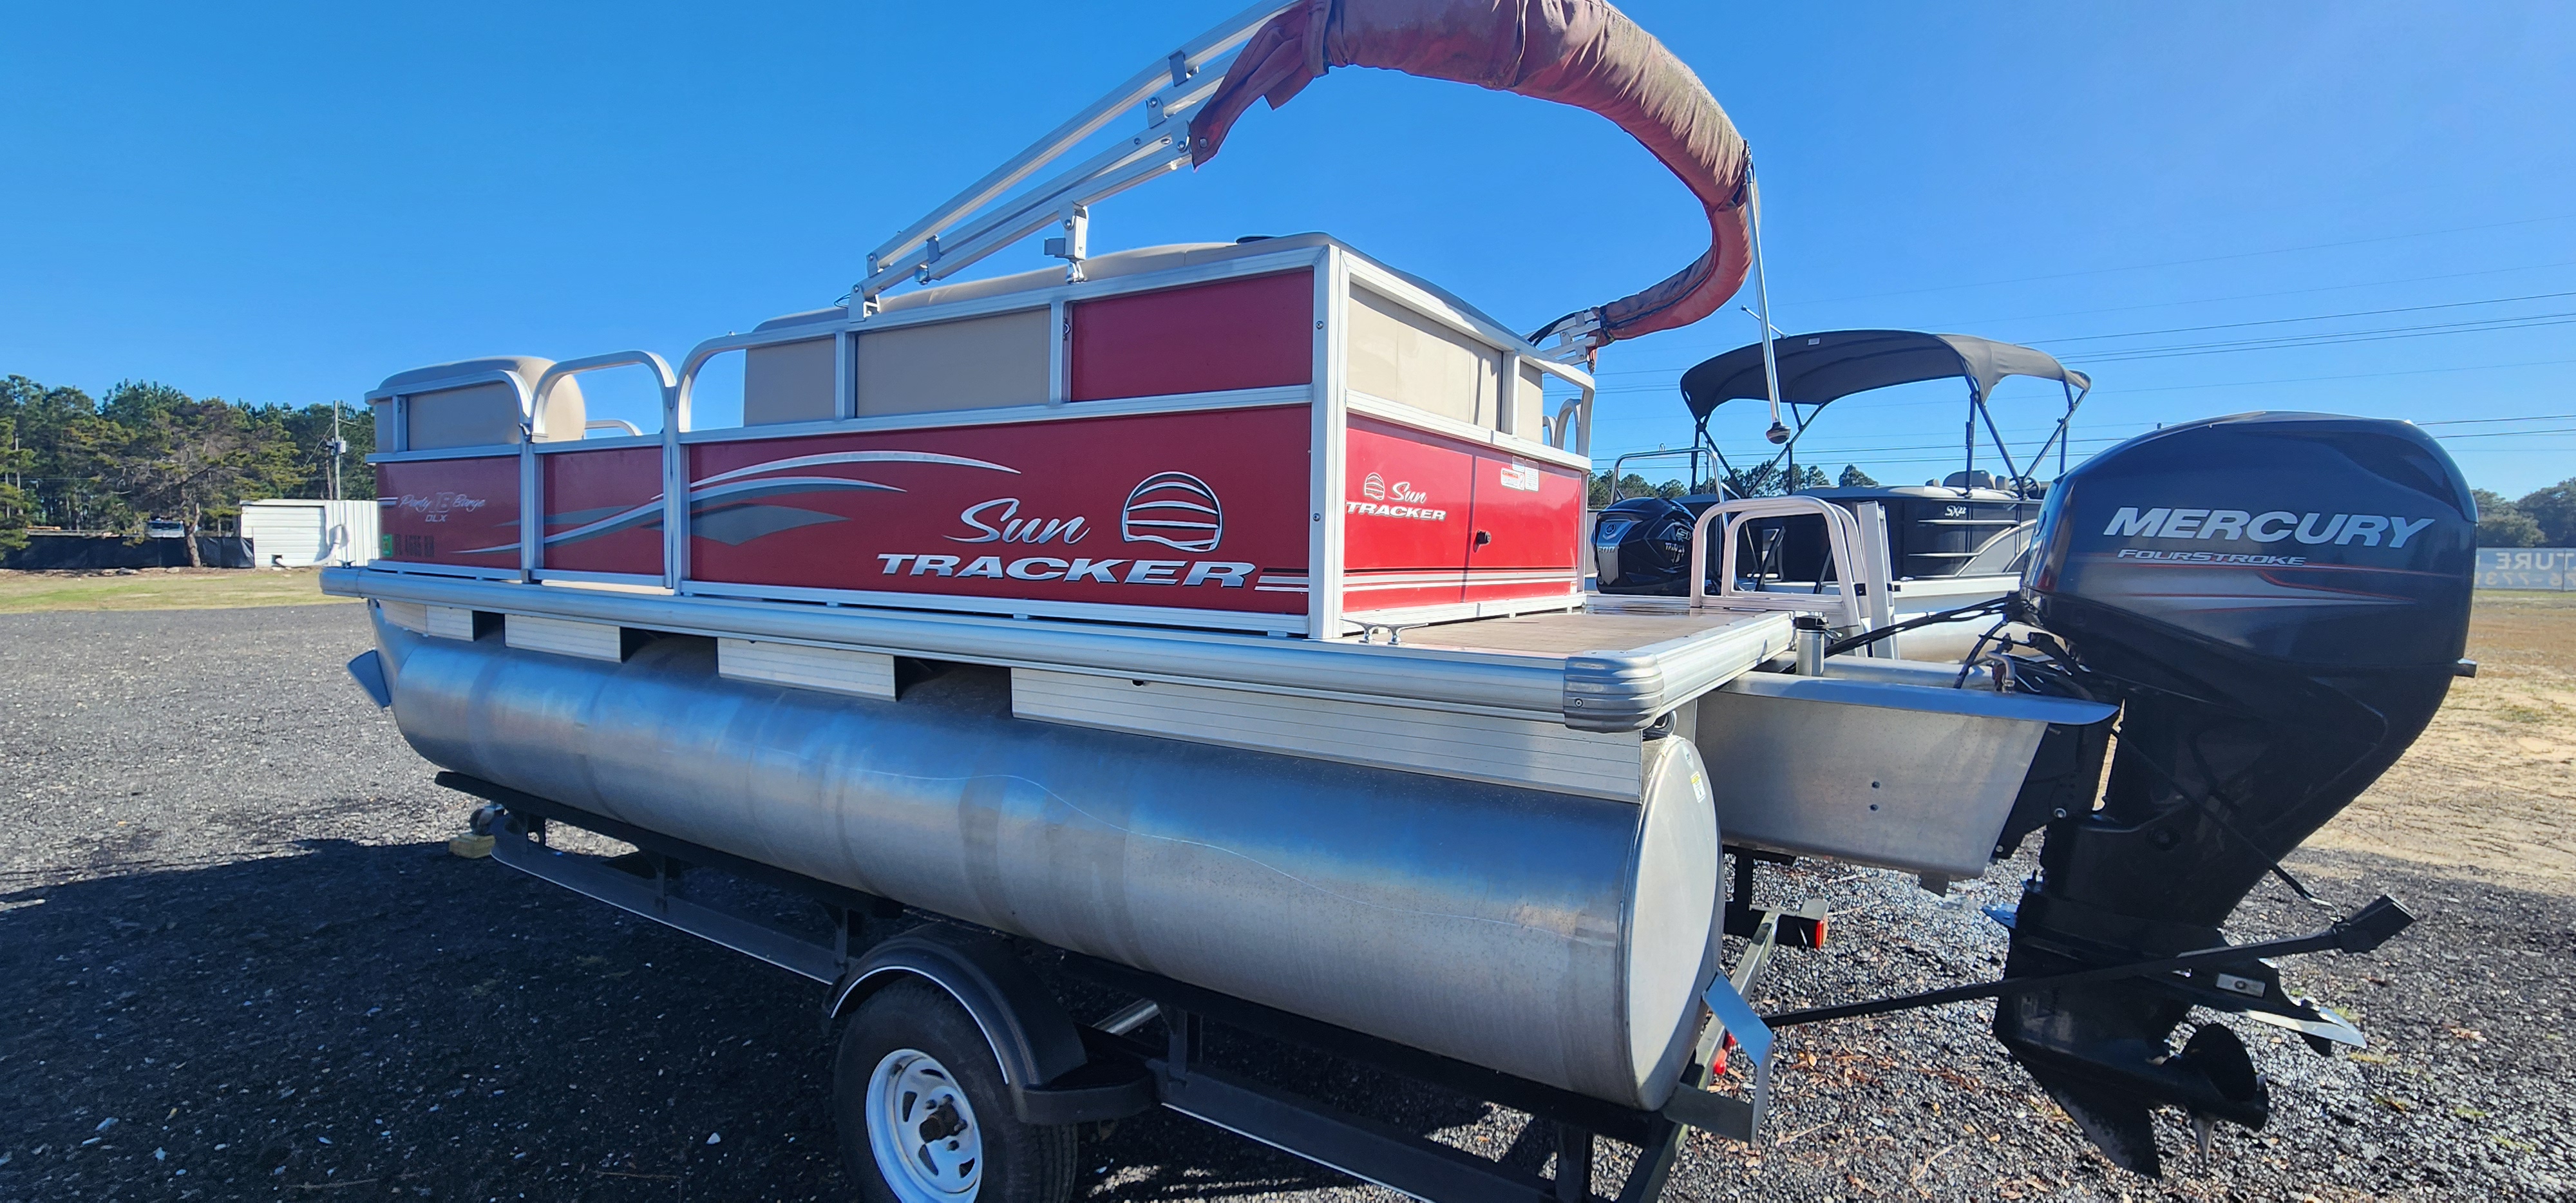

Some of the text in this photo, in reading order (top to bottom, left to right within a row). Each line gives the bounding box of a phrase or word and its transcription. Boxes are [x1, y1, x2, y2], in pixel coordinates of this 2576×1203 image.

[1387, 482, 1427, 504] Sun
[399, 495, 432, 513] Party
[452, 494, 486, 513] Barge
[1345, 502, 1447, 521] TRACKER
[425, 514, 448, 522] DLX
[942, 497, 1090, 544] Sun
[2103, 507, 2436, 549] MERCURY
[2117, 549, 2307, 565] FOURSTROKE
[876, 553, 1256, 588] TRACKER
